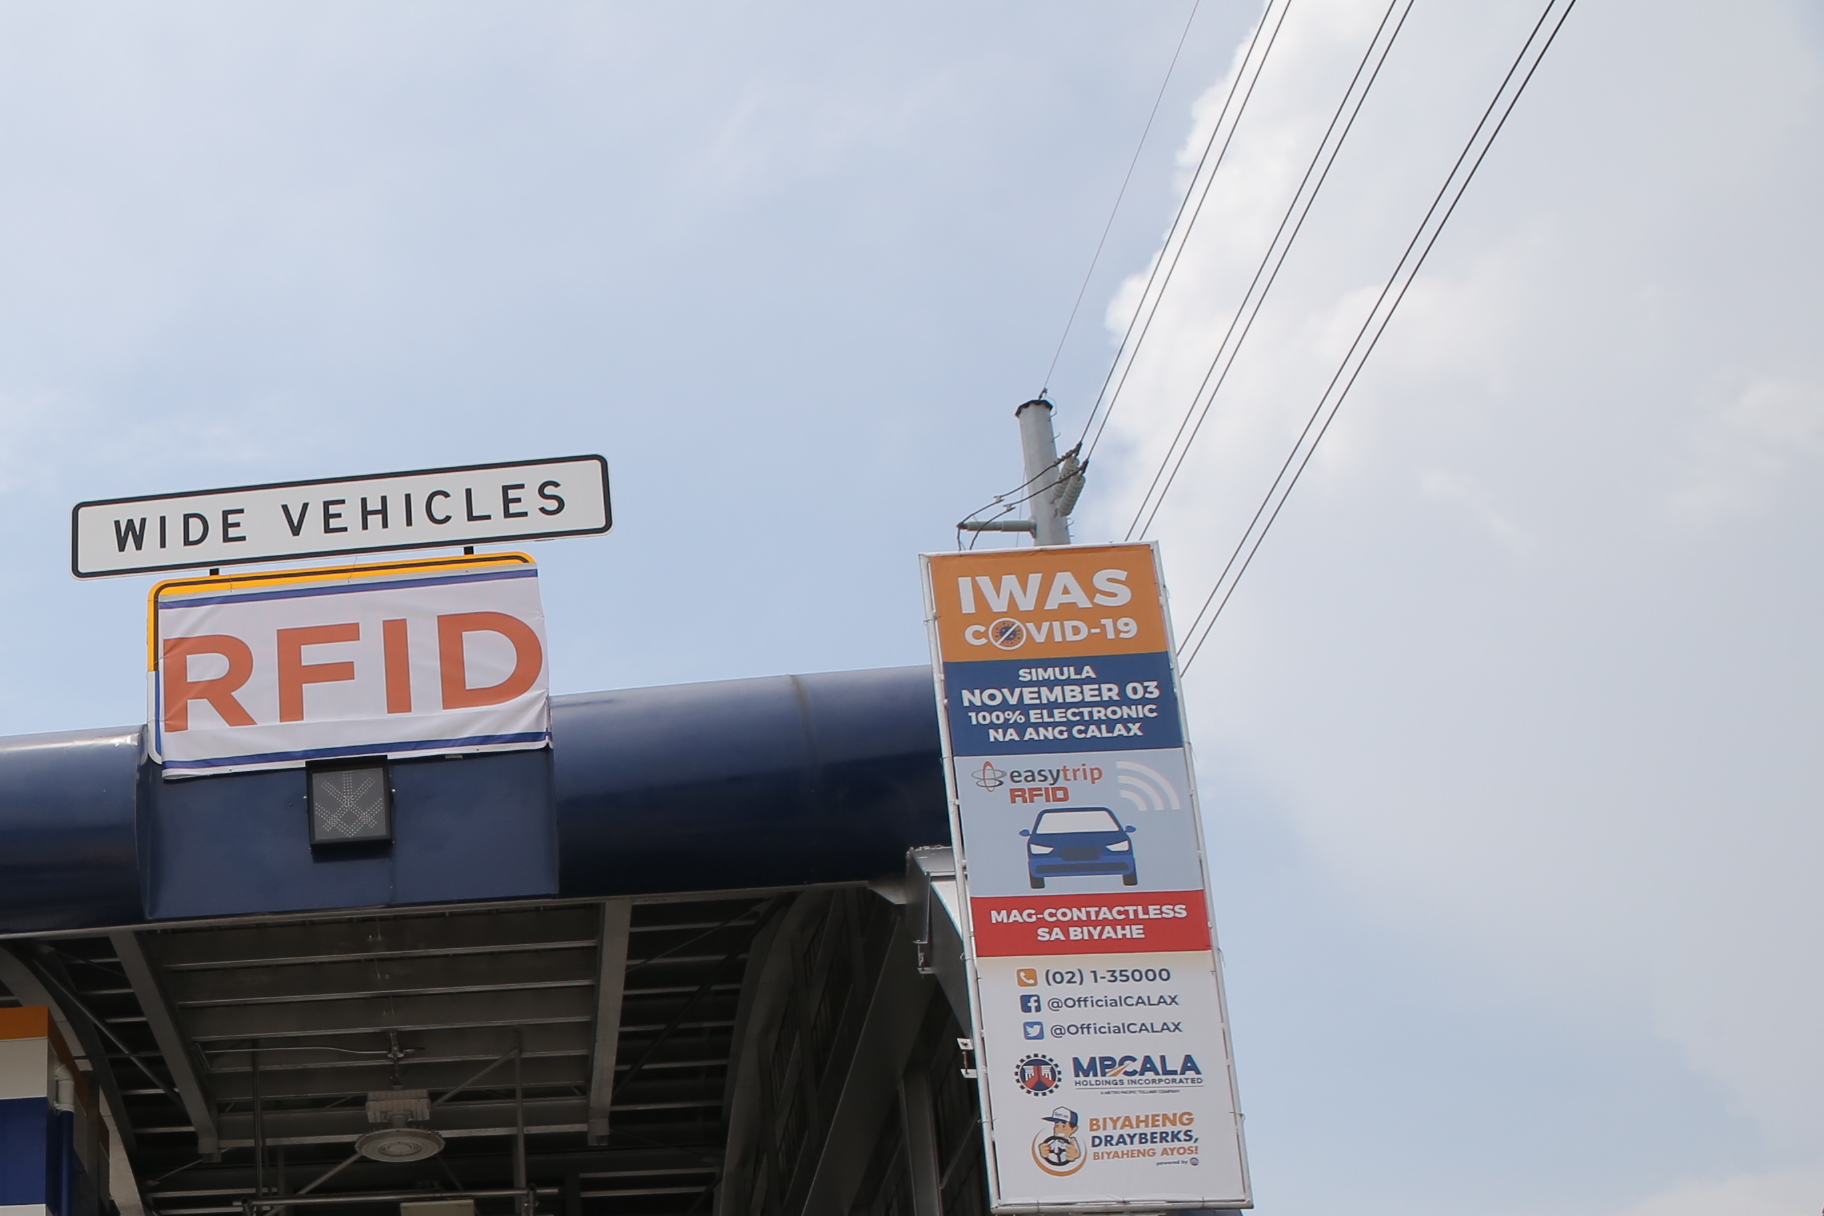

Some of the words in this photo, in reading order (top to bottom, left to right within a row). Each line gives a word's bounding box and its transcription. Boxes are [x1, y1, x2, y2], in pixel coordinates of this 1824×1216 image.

[113, 508, 246, 553] WIDE
[281, 480, 566, 538] VEHICLES
[957, 568, 1132, 614] IWAS
[964, 617, 1138, 650] COVID-19
[163, 611, 543, 732] RFID
[1018, 665, 1096, 682] SIMULA
[961, 683, 1120, 707] NOVEMBER
[1126, 681, 1160, 700] 03
[968, 709, 1025, 725] 100%
[1030, 704, 1158, 723] ELECTRONIC
[988, 728, 1020, 742] NA
[1023, 726, 1068, 741] ANG
[1072, 722, 1143, 738] CALAX
[1009, 764, 1103, 785] easytrip
[1009, 786, 1069, 804] RFID
[990, 904, 1188, 924] MAG-CONTACTLESS
[1037, 927, 1065, 941] SA
[1068, 925, 1145, 940] BIYAHE
[1045, 969, 1084, 986] (02)
[1090, 968, 1171, 984] 1-35000
[1047, 994, 1179, 1012] @OfficialCALAX
[1050, 1021, 1183, 1038] @OfficialCALAX
[1072, 1054, 1202, 1078] MPCALA
[1074, 1078, 1125, 1087] HOLDINGS
[1127, 1077, 1203, 1086] INCORPORATED
[1089, 1111, 1194, 1132] BIYAHENG
[1091, 1129, 1199, 1148] DRAYBERKS,
[1092, 1148, 1156, 1161] BIYAHENG
[1161, 1146, 1199, 1157] AYOS!
